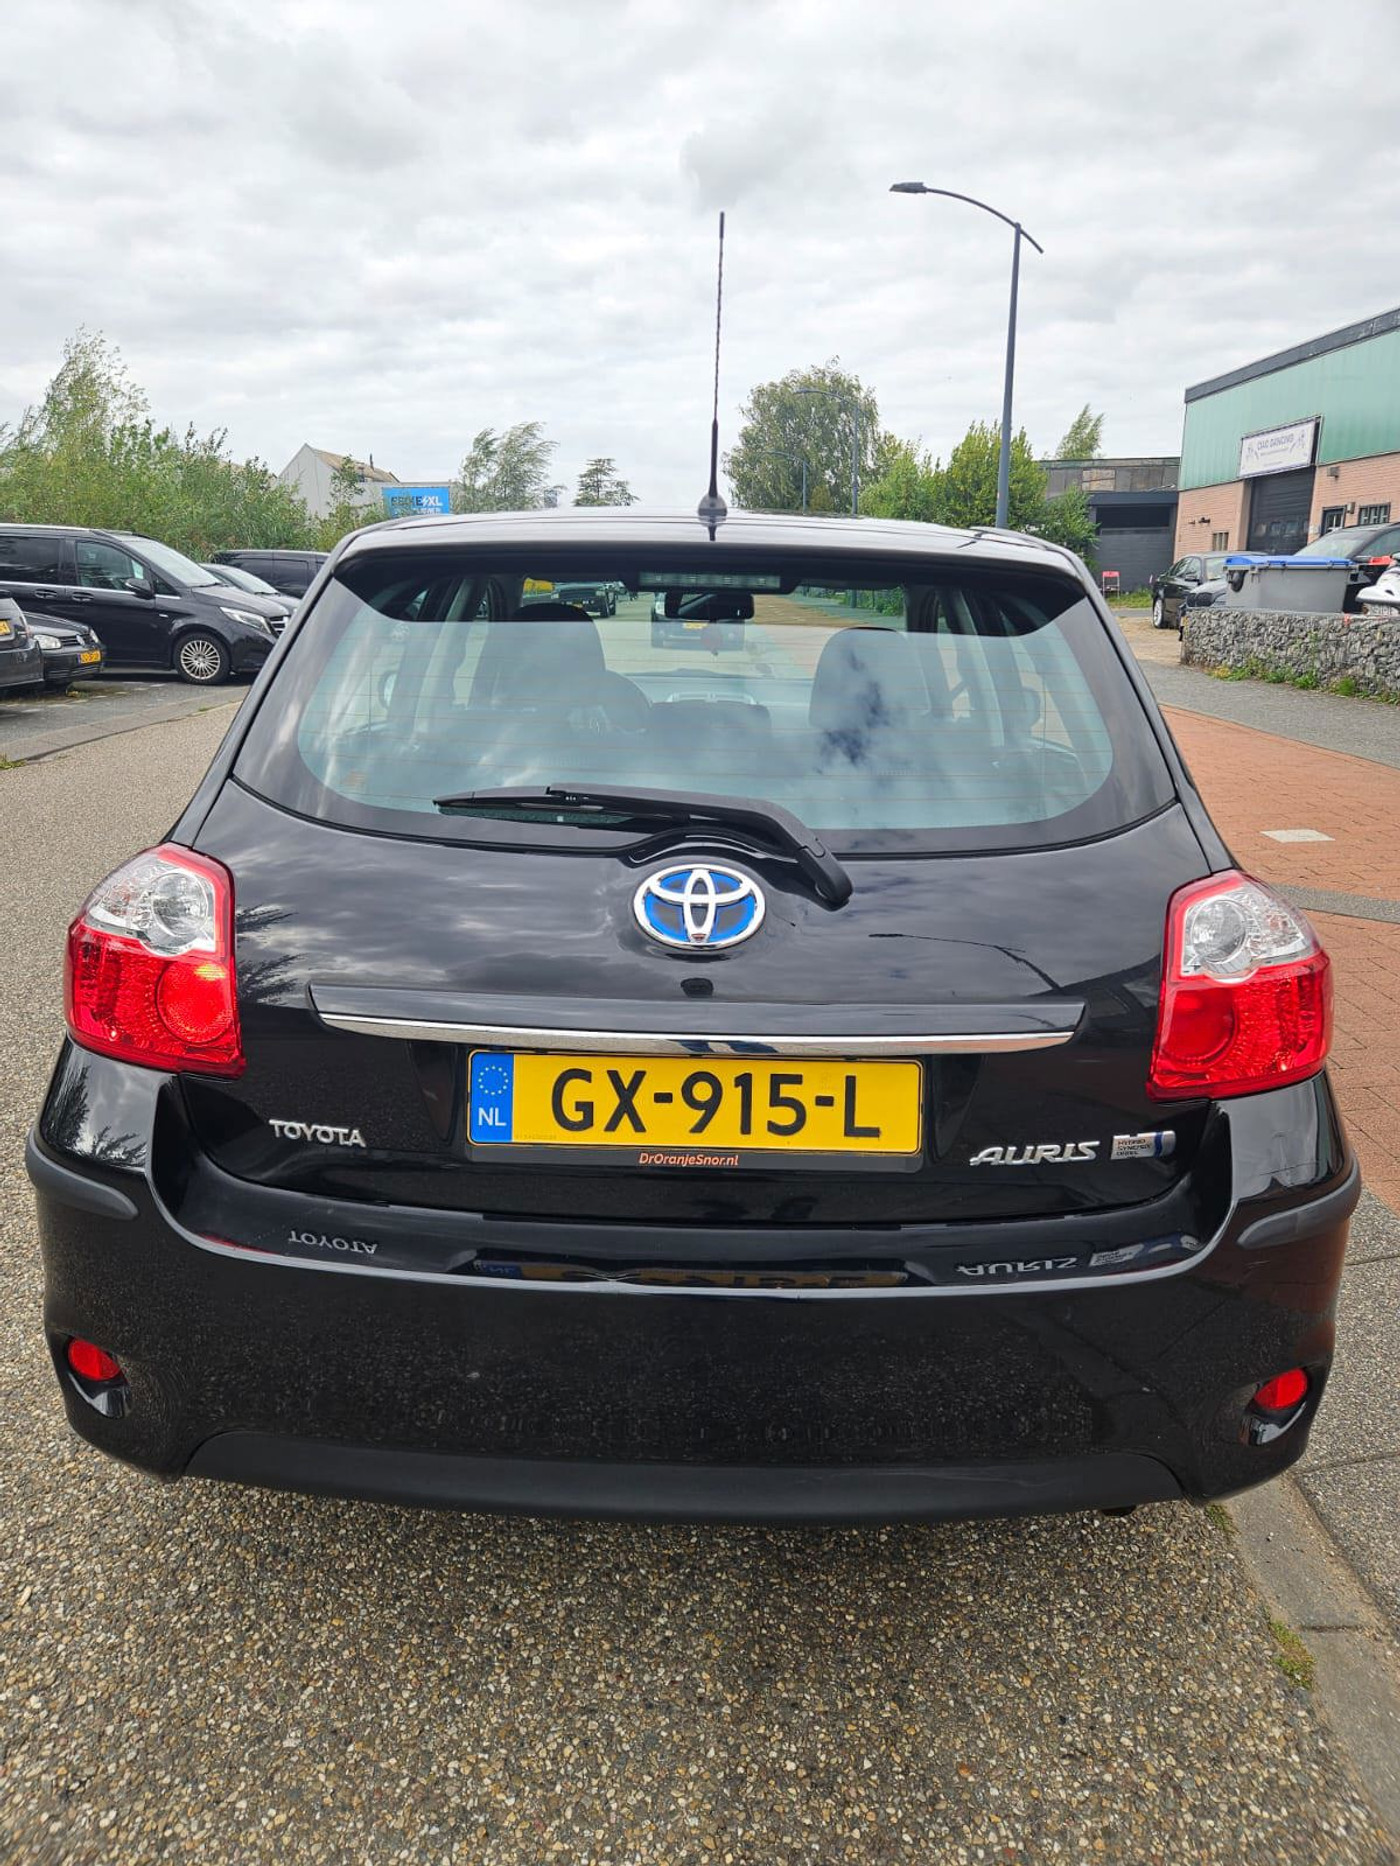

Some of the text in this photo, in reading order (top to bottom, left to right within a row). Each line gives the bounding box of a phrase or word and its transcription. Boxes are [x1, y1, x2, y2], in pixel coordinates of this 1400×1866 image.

[478, 1107, 507, 1126] NL
[551, 1068, 881, 1139] GX-915-L
[268, 1119, 366, 1148] TOYOTA
[639, 1152, 739, 1167] DrOranjeSnor.nl
[969, 1140, 1101, 1166] AURIS
